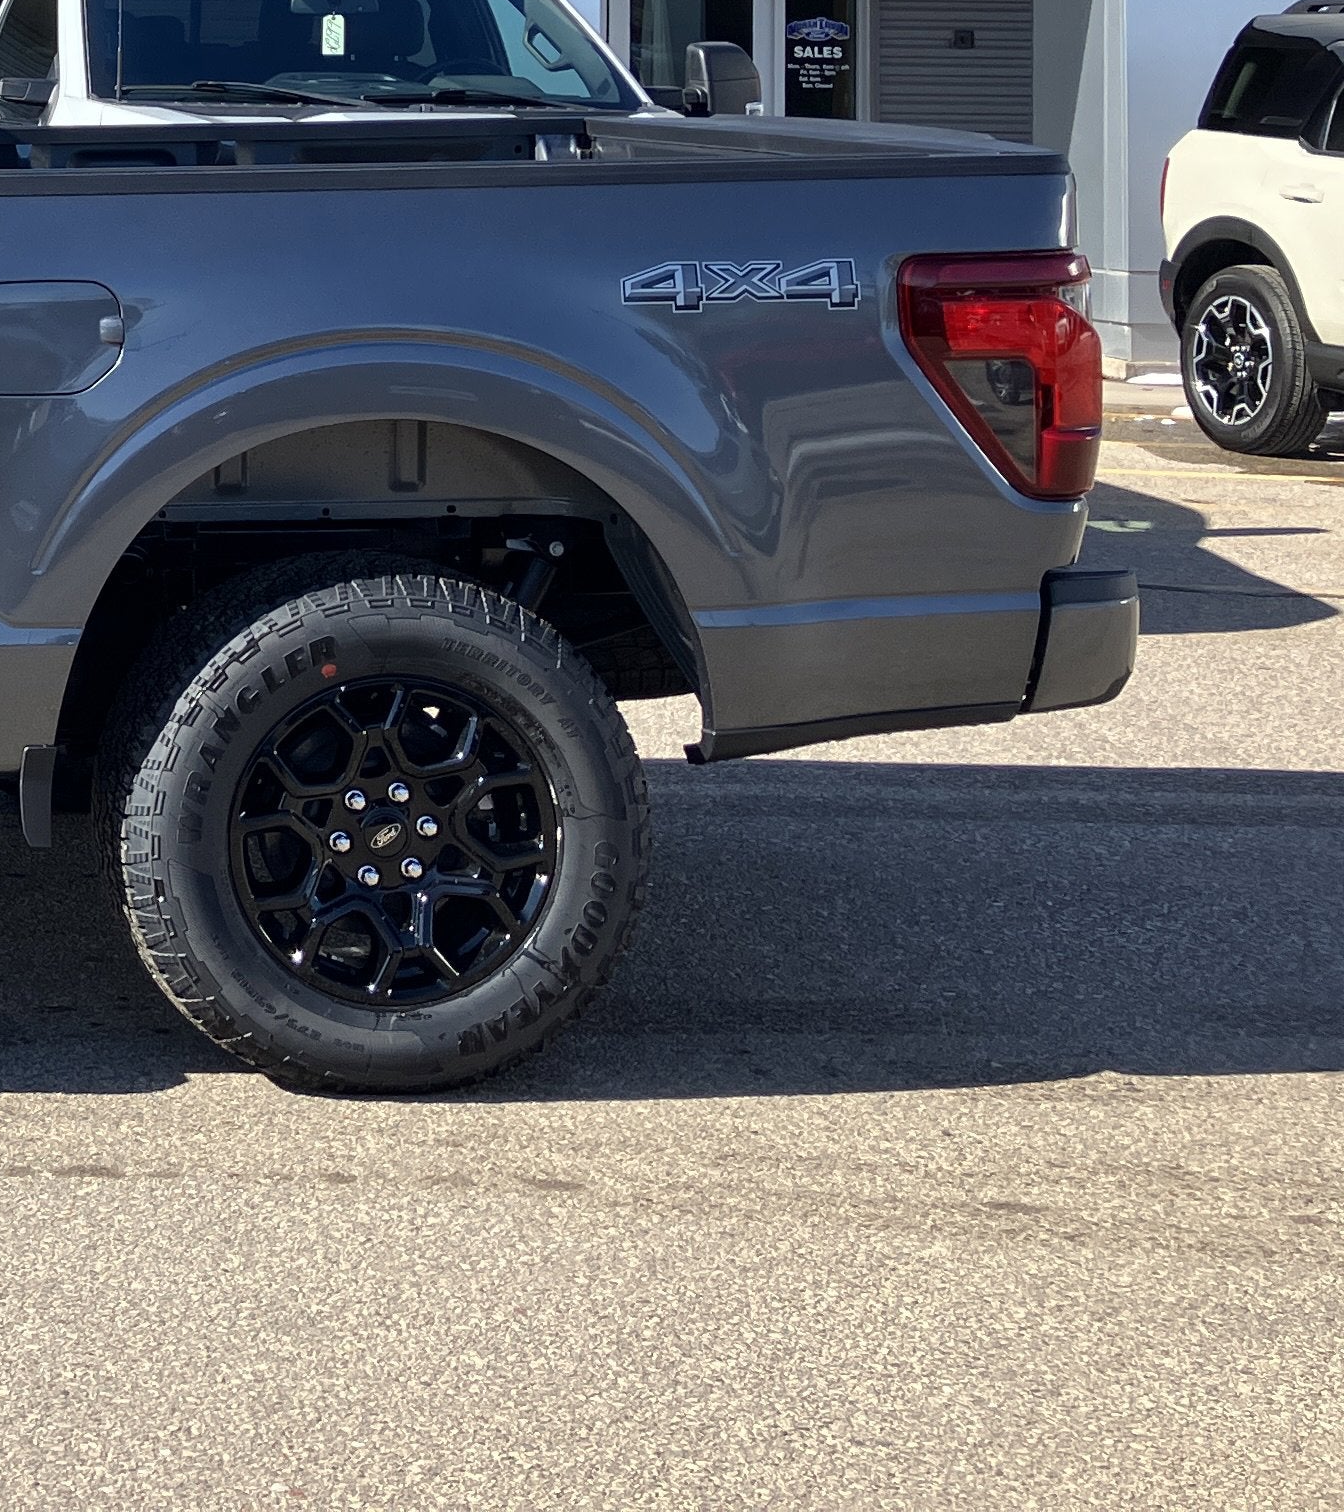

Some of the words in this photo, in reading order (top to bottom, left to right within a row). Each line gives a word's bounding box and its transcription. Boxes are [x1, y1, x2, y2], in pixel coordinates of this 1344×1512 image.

[793, 45, 843, 59] SALES
[441, 637, 557, 705] TERRITORY
[177, 635, 337, 844] WRANGLER
